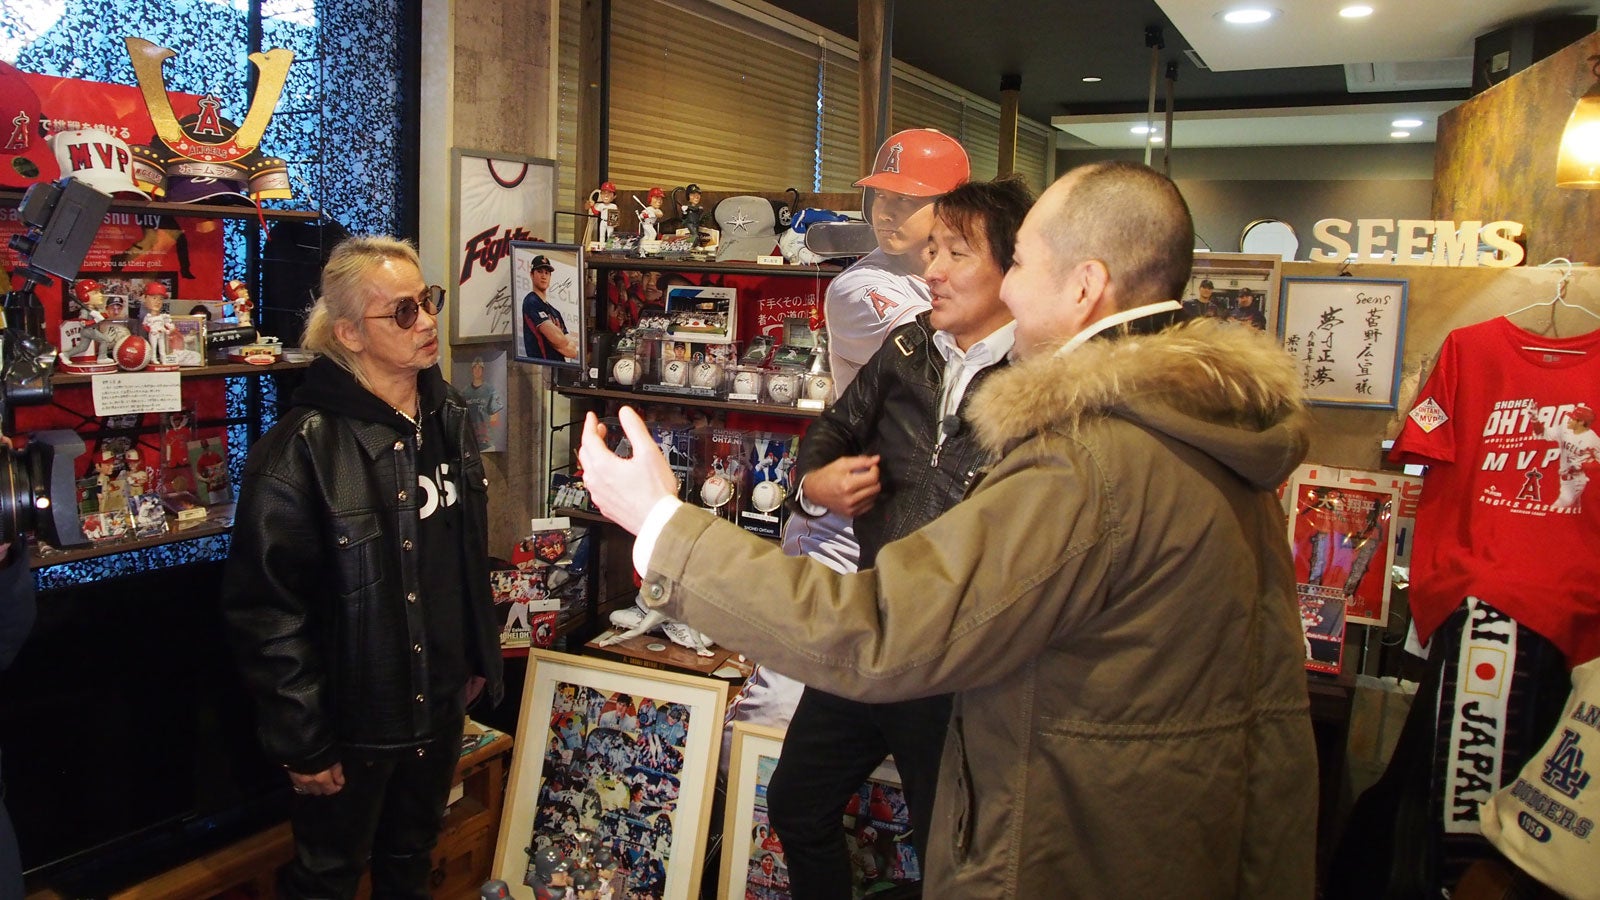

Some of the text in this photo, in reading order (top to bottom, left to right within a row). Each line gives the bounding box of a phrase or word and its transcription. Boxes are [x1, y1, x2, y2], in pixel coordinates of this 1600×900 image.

[67, 142, 129, 173] MVP
[188, 145, 228, 159] ANGELS
[882, 143, 904, 173] A
[178, 163, 237, 177] ホームラン
[1310, 218, 1524, 268] SEEMS
[102, 261, 117, 270] you
[128, 259, 145, 267] their
[147, 260, 163, 269] goal.
[863, 286, 899, 322] A
[1481, 448, 1560, 471] MVP
[1479, 495, 1582, 514] ANGELS BASEBALL
[1453, 700, 1498, 822] JAPAN
[1540, 726, 1591, 800] LA
[1521, 814, 1545, 838] 1958
